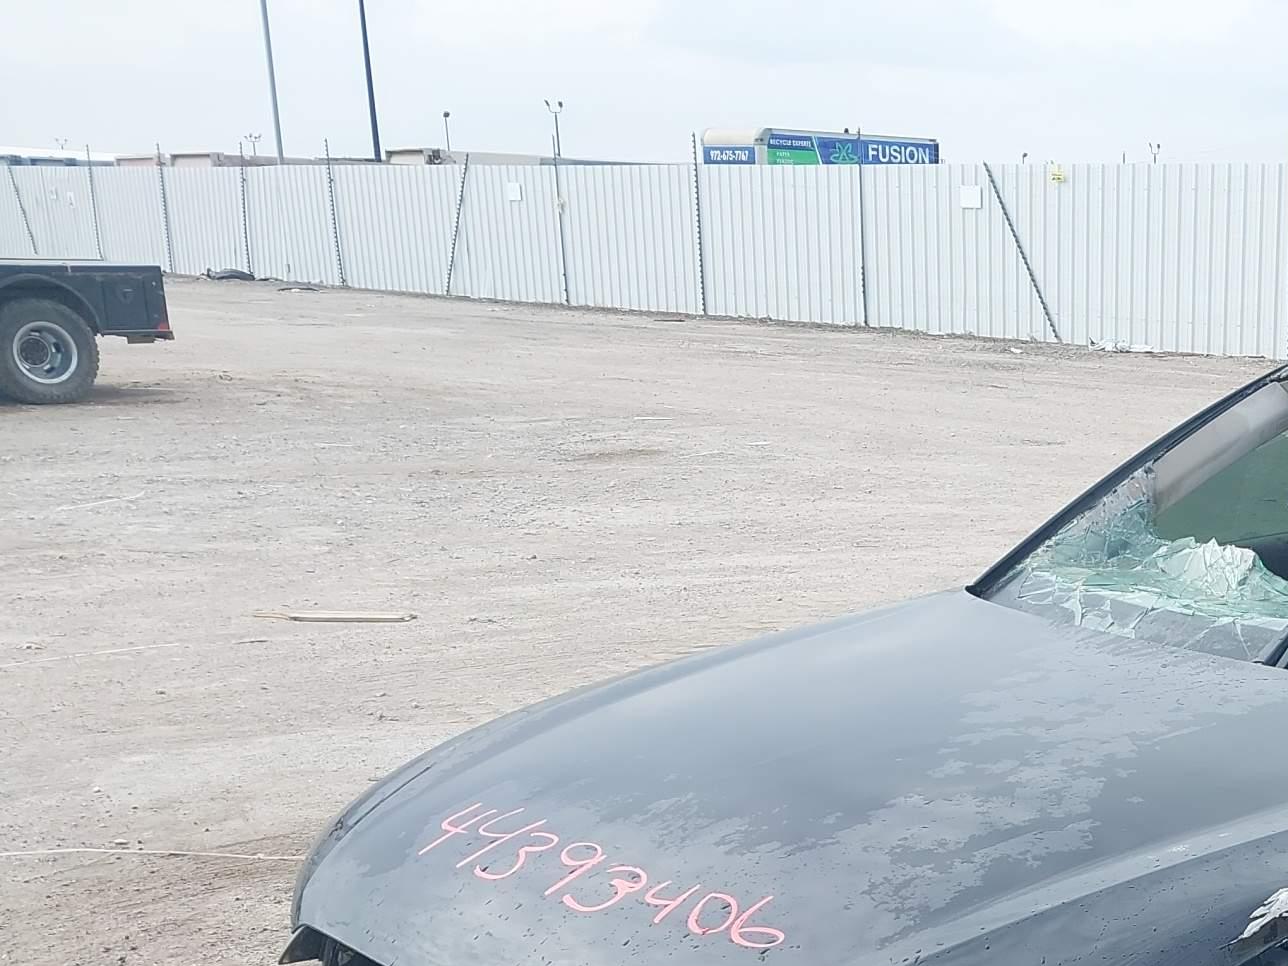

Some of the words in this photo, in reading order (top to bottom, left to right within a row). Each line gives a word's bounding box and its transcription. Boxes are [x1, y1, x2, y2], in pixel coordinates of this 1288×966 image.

[710, 150, 748, 161] 972-675-7767
[868, 143, 929, 164] FUSION
[418, 802, 785, 948] 44393406
